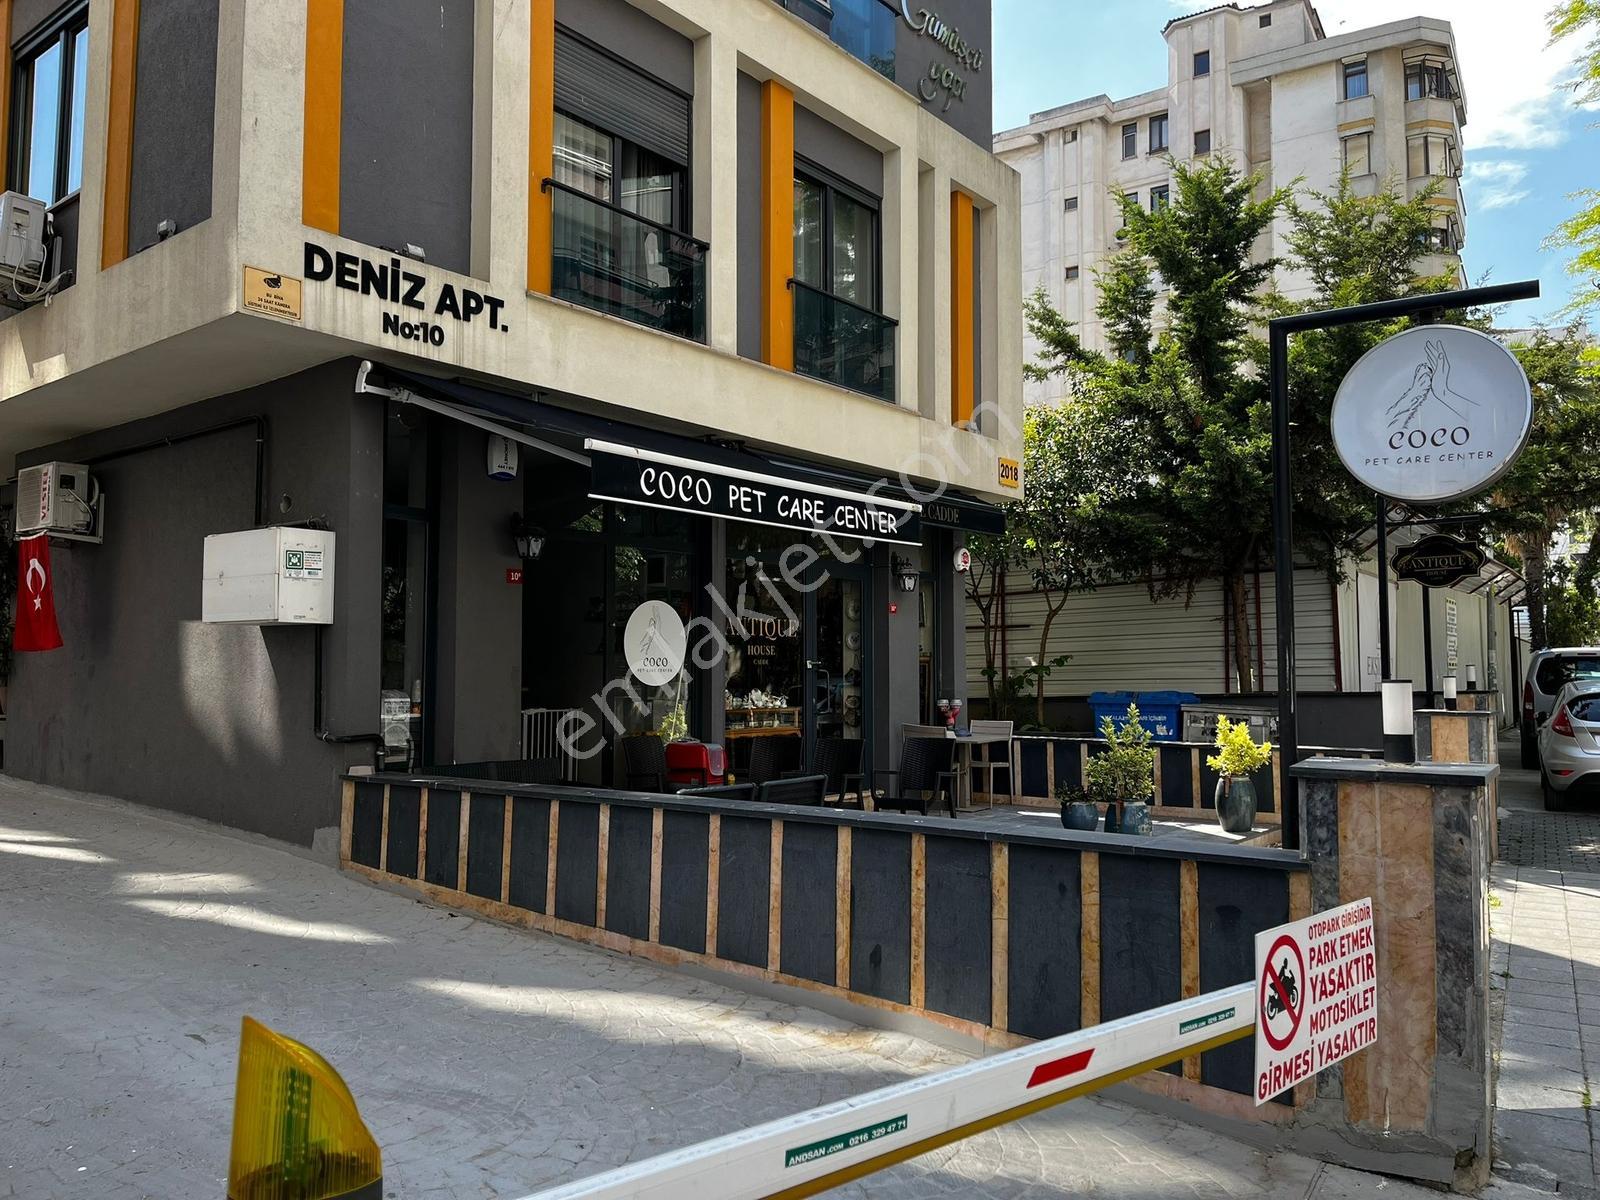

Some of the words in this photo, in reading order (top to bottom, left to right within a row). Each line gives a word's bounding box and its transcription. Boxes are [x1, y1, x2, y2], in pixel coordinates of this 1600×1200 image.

[304, 241, 426, 310] DENİZ
[434, 283, 509, 333] APT.
[382, 311, 445, 346] No:10
[1388, 426, 1470, 450] COCO
[1000, 463, 1019, 482] 2018
[1365, 457, 1389, 466] PET
[1397, 455, 1431, 465] CARE
[1438, 451, 1493, 462] CENTER
[640, 467, 712, 505] COCO
[729, 484, 767, 513] PET
[777, 495, 824, 524] CARE
[834, 505, 898, 535] CENTER
[928, 503, 960, 523] CADDE
[1408, 555, 1466, 569] ANTIQUE
[725, 616, 798, 641] ANTIQUE
[643, 657, 668, 668] COCO
[747, 644, 776, 656] HOUSE
[1308, 915, 1340, 941] OTOPARK
[1341, 903, 1371, 929] GİRİŞİDİR
[1309, 938, 1338, 970] PARK
[1340, 925, 1373, 958] ETMEK
[1310, 952, 1375, 1005] YASAKTIR
[1309, 986, 1376, 1038] MOTOSİKLET
[1258, 1039, 1315, 1101] GİRMESİ
[1318, 1016, 1376, 1067] YASAKTIR
[788, 1147, 826, 1167] ANDSAN
[848, 1133, 869, 1147] 0216
[871, 1127, 886, 1139] 329
[886, 1124, 896, 1133] 47
[897, 1119, 906, 1129] 71
